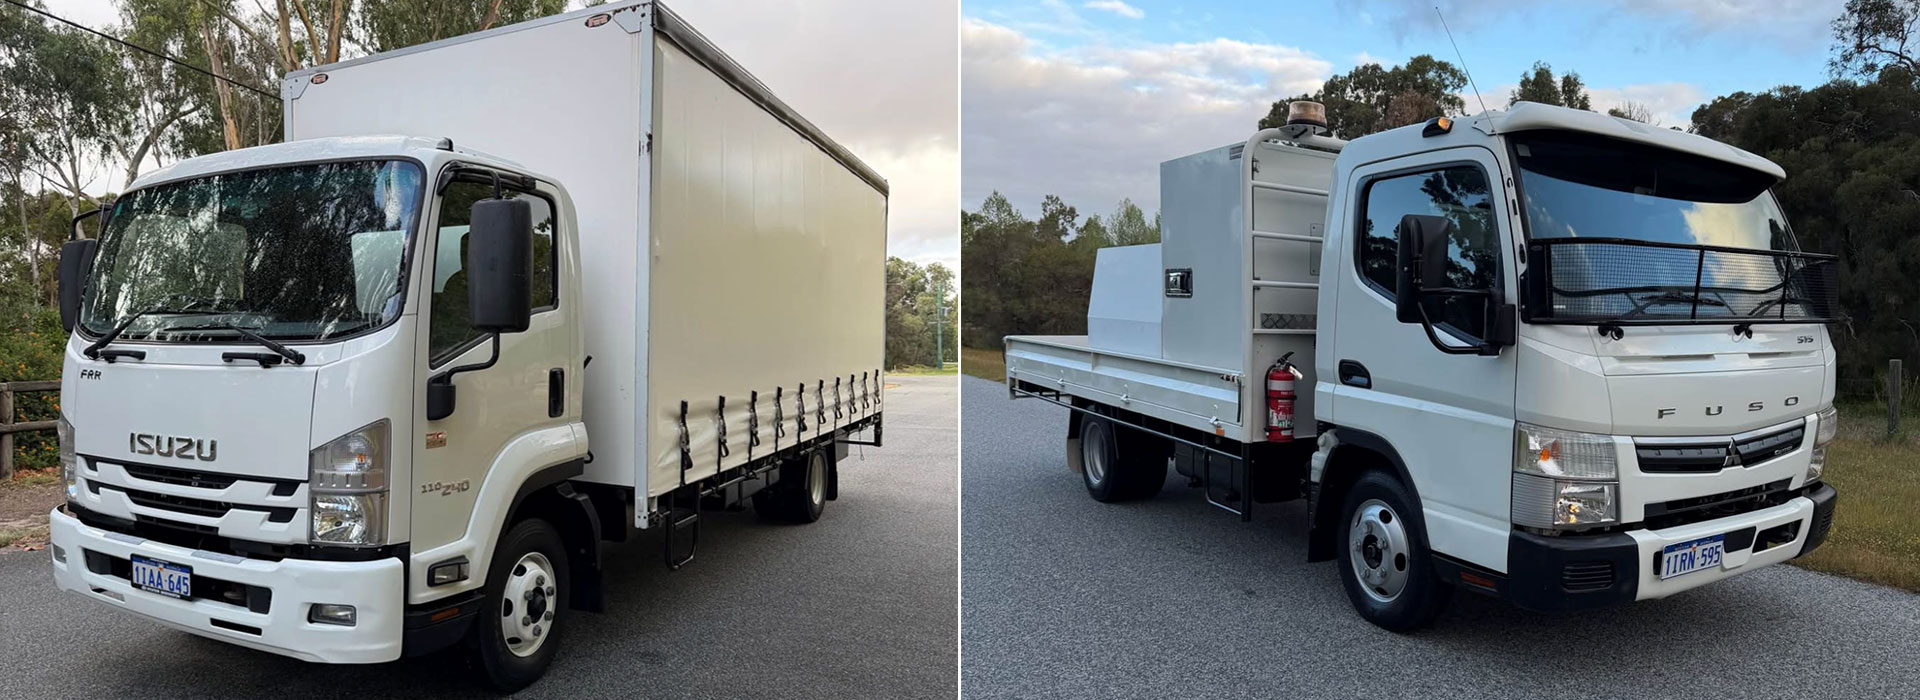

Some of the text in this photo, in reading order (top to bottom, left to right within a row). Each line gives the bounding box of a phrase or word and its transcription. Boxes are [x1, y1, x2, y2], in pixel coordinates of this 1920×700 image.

[80, 369, 102, 381] FRR
[1657, 396, 1799, 420] FUSO
[129, 432, 217, 462] ISUZU
[442, 479, 470, 497] 240
